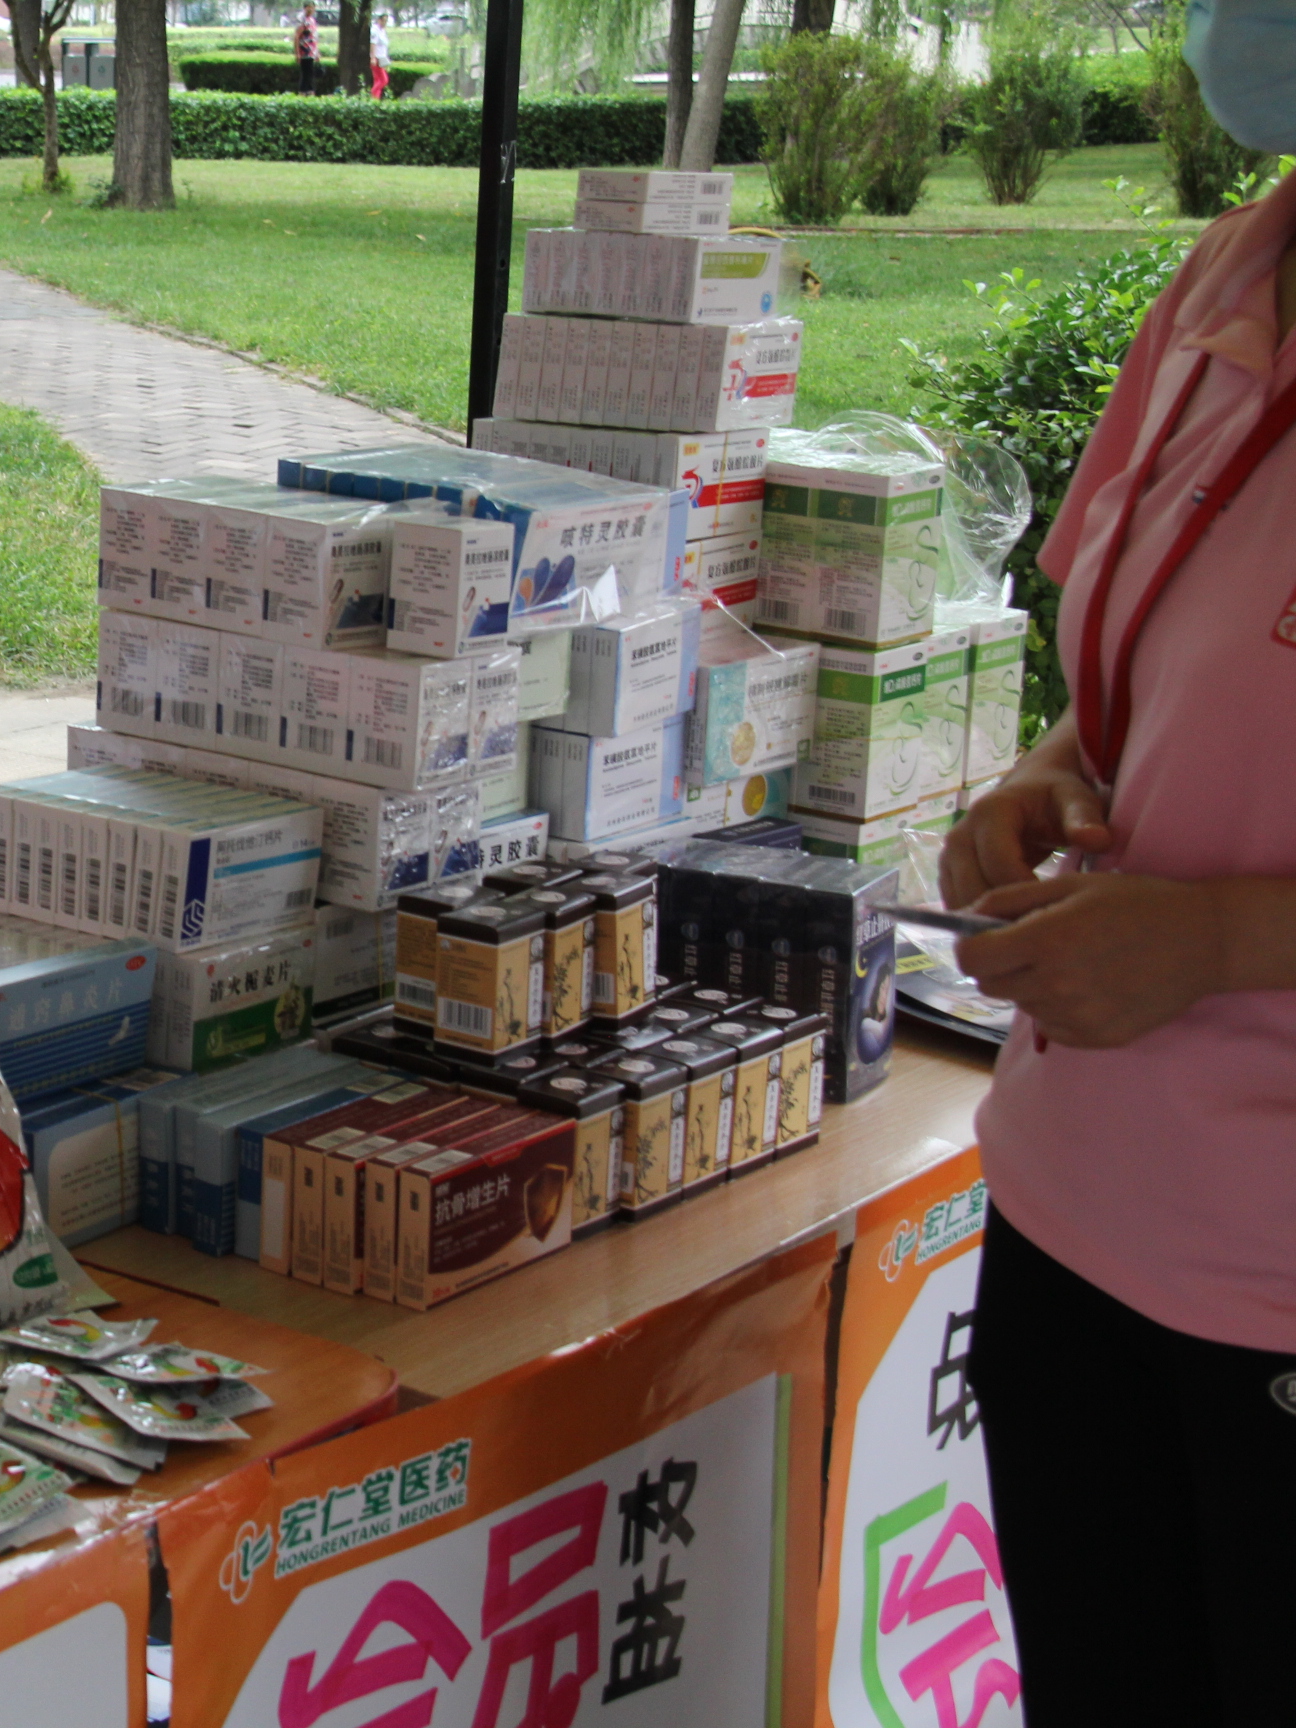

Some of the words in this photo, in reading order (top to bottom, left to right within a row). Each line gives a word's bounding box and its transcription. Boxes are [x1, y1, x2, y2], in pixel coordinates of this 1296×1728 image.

[560, 515, 647, 548] 咳特灵胶囊
[435, 1173, 510, 1227] 抗骨增生片
[923, 1180, 986, 1242] 宏仁堂
[278, 1440, 470, 1550] 宏仁堂医药
[276, 1519, 390, 1574] HONGRENTANG
[396, 1490, 466, 1529] MEDICINE
